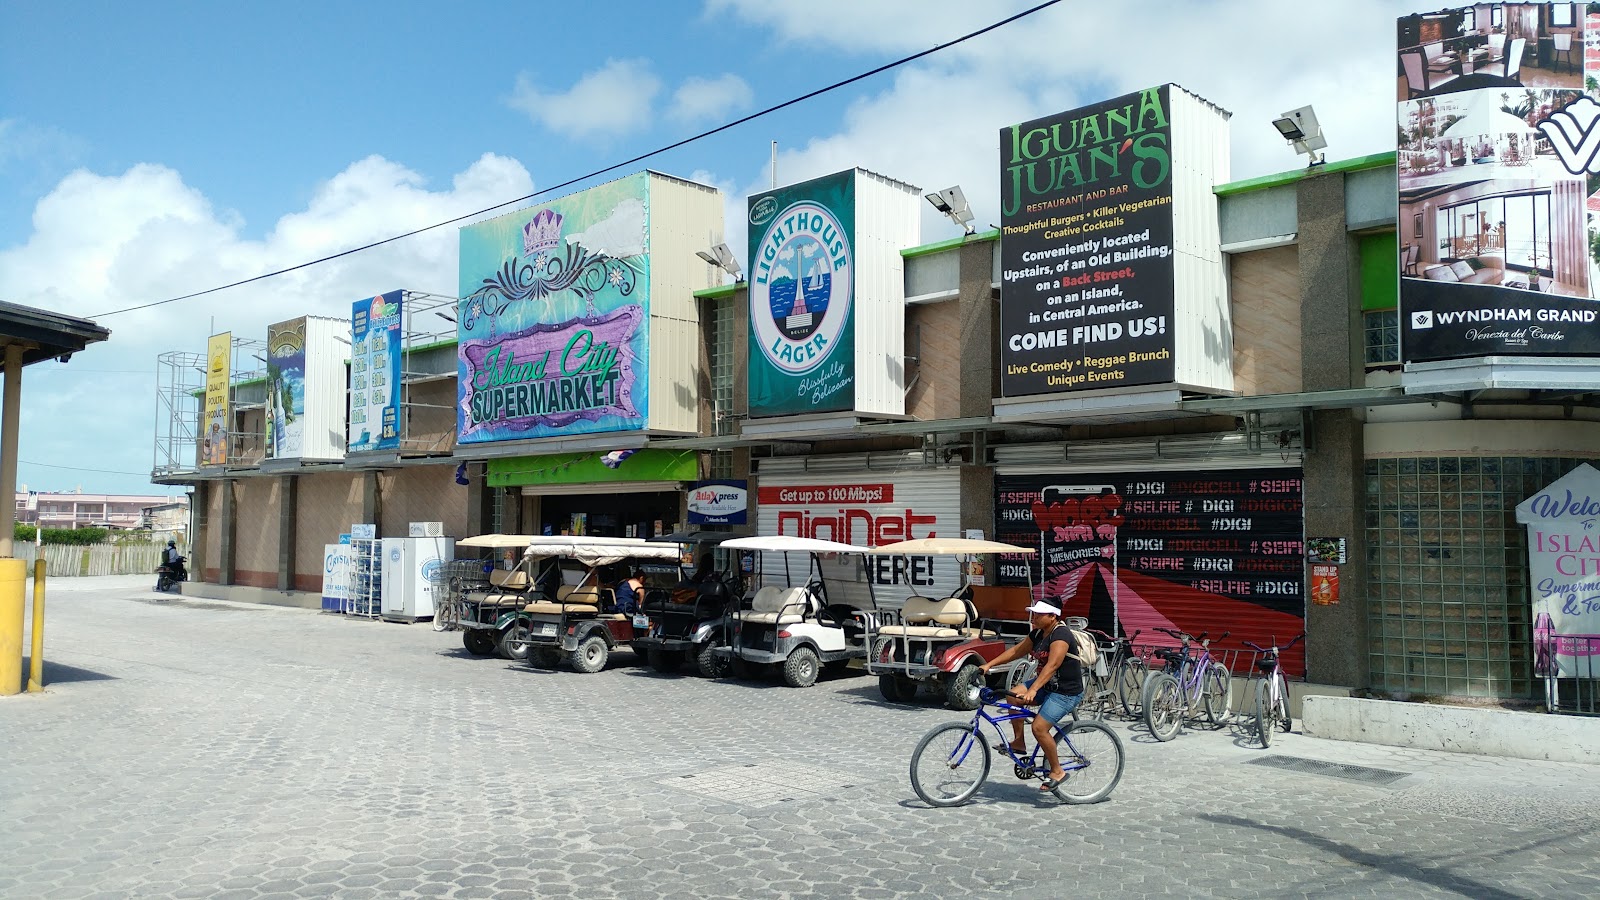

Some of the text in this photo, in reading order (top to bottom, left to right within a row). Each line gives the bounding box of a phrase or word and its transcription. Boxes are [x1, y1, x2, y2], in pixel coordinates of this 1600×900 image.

[1009, 86, 1168, 163] IGUANA
[1002, 133, 1169, 216] JUAN'S
[1026, 185, 1128, 213] RESTAURANT AND BAR
[1003, 196, 1172, 235] Thoughtful Burgers Killer Vegetarian
[1044, 217, 1124, 240] Creative Cocktails
[757, 212, 847, 287] LIGHTHOUSE
[1022, 229, 1149, 262] Conveniently located
[1004, 244, 1173, 282] Upstairs, of an Old Building,
[1036, 267, 1136, 291] on a Back Street,
[1047, 284, 1123, 306] on an Island,
[1029, 299, 1143, 324] in Central America.
[1437, 309, 1531, 324] WYNDHAM
[1009, 316, 1166, 351] COME FIND US!
[1466, 326, 1564, 341] Venezia del Caribe
[772, 333, 828, 363] LAGER
[474, 329, 618, 391] Island City
[1008, 348, 1169, 375] Live Comedy Reggae Brunch
[209, 382, 225, 392] QUALITY
[798, 361, 845, 396] Blissfully
[1047, 370, 1124, 387] Unique Events
[208, 395, 225, 405] POULTRY
[471, 371, 621, 424] SUPERMARKET
[206, 408, 226, 419] PRODUCTS
[780, 487, 883, 504] Get up to 100 Mbps!
[1002, 509, 1033, 521] #DIGI
[1211, 518, 1252, 531] #DIGI
[1581, 518, 1597, 530] To
[778, 509, 936, 548] DigiNet
[1054, 524, 1094, 542] DATA
[1127, 539, 1163, 551] #DIGI
[1536, 532, 1600, 553] ISLA
[1050, 546, 1101, 563] MEMORIES
[1193, 558, 1233, 571] #DIGI
[856, 554, 934, 586] HERE!
[1256, 582, 1298, 595] #DIGI
[1562, 594, 1581, 615] &
